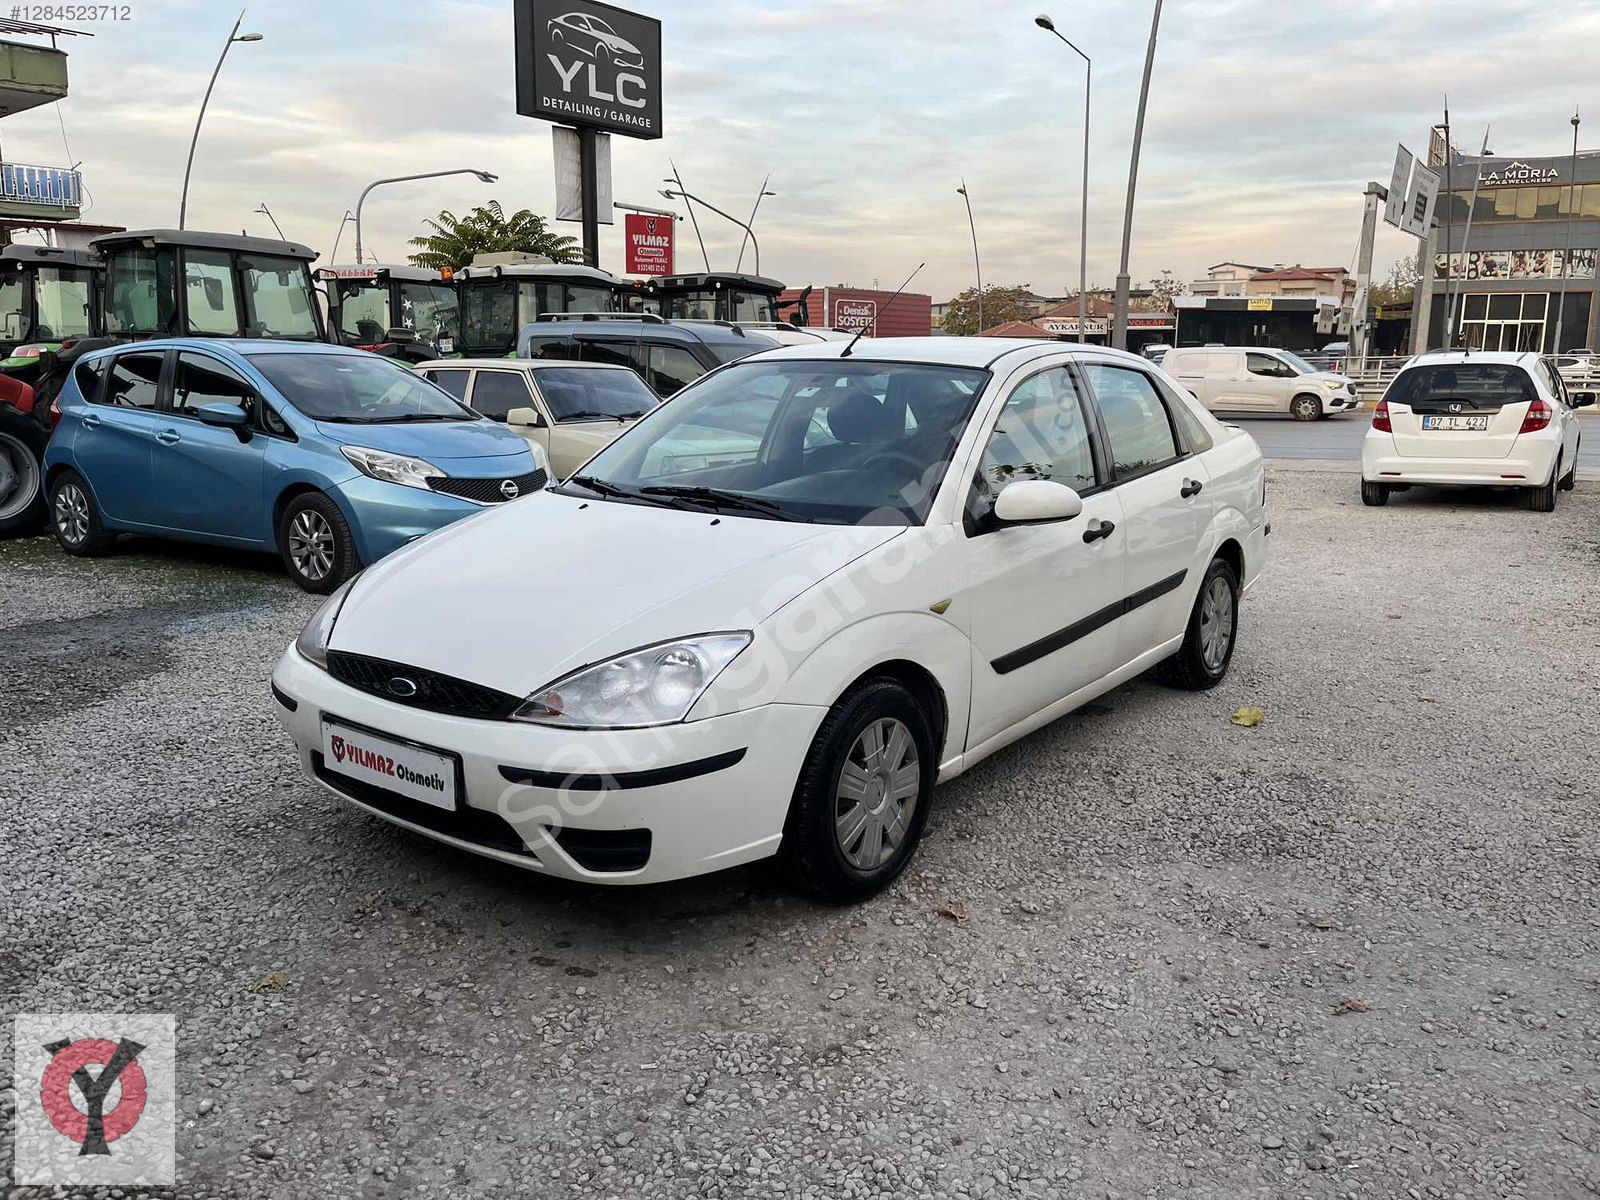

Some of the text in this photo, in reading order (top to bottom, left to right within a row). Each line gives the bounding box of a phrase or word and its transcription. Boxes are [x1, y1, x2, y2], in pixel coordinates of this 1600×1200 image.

[547, 53, 647, 109] YLC
[543, 96, 601, 119] DETAILING
[611, 111, 651, 128] GARAGE
[1478, 168, 1559, 181] LA MORIA
[632, 234, 669, 247] YILMAZ
[1430, 417, 1485, 427] 07 TL 422
[346, 743, 445, 792] YILMAZ Otomotiv
